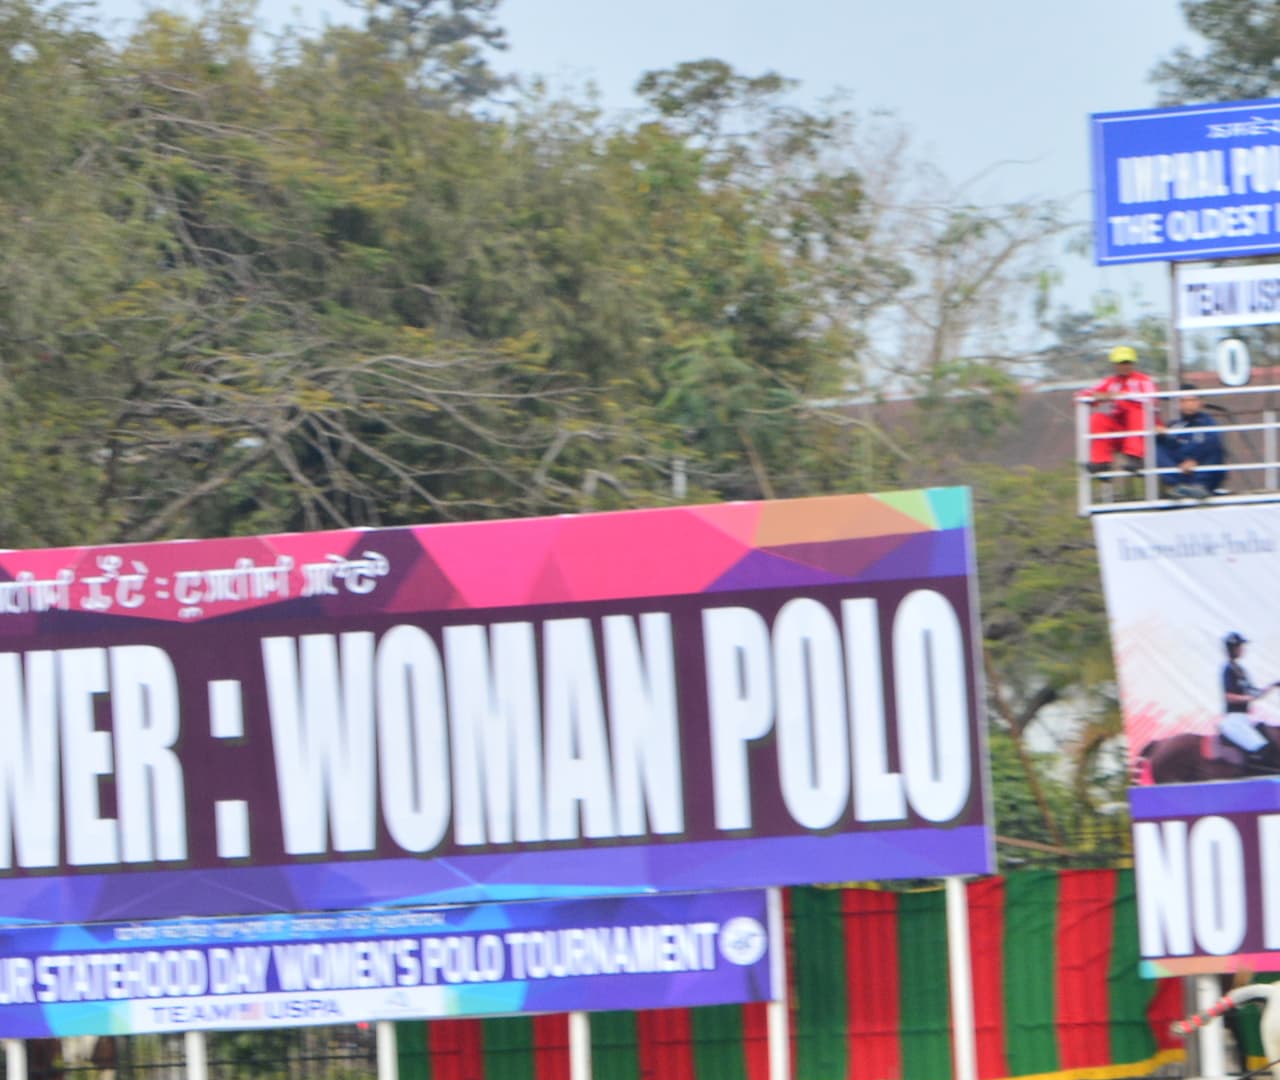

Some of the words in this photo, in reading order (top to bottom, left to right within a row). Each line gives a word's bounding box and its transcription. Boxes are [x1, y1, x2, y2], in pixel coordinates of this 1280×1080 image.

[1108, 213, 1163, 246] THE
[1166, 204, 1272, 242] OLDEST
[1218, 338, 1250, 386] 0
[261, 612, 685, 855] WOMAN
[701, 589, 971, 831] POLO
[1132, 816, 1247, 957] NO
[35, 949, 208, 1003] STATEHOOD
[209, 946, 271, 994] DAY
[272, 938, 421, 991] WOMEN'S
[422, 933, 505, 984] POLO
[504, 922, 720, 980] TOURNAMENT
[266, 999, 342, 1019] USPA
